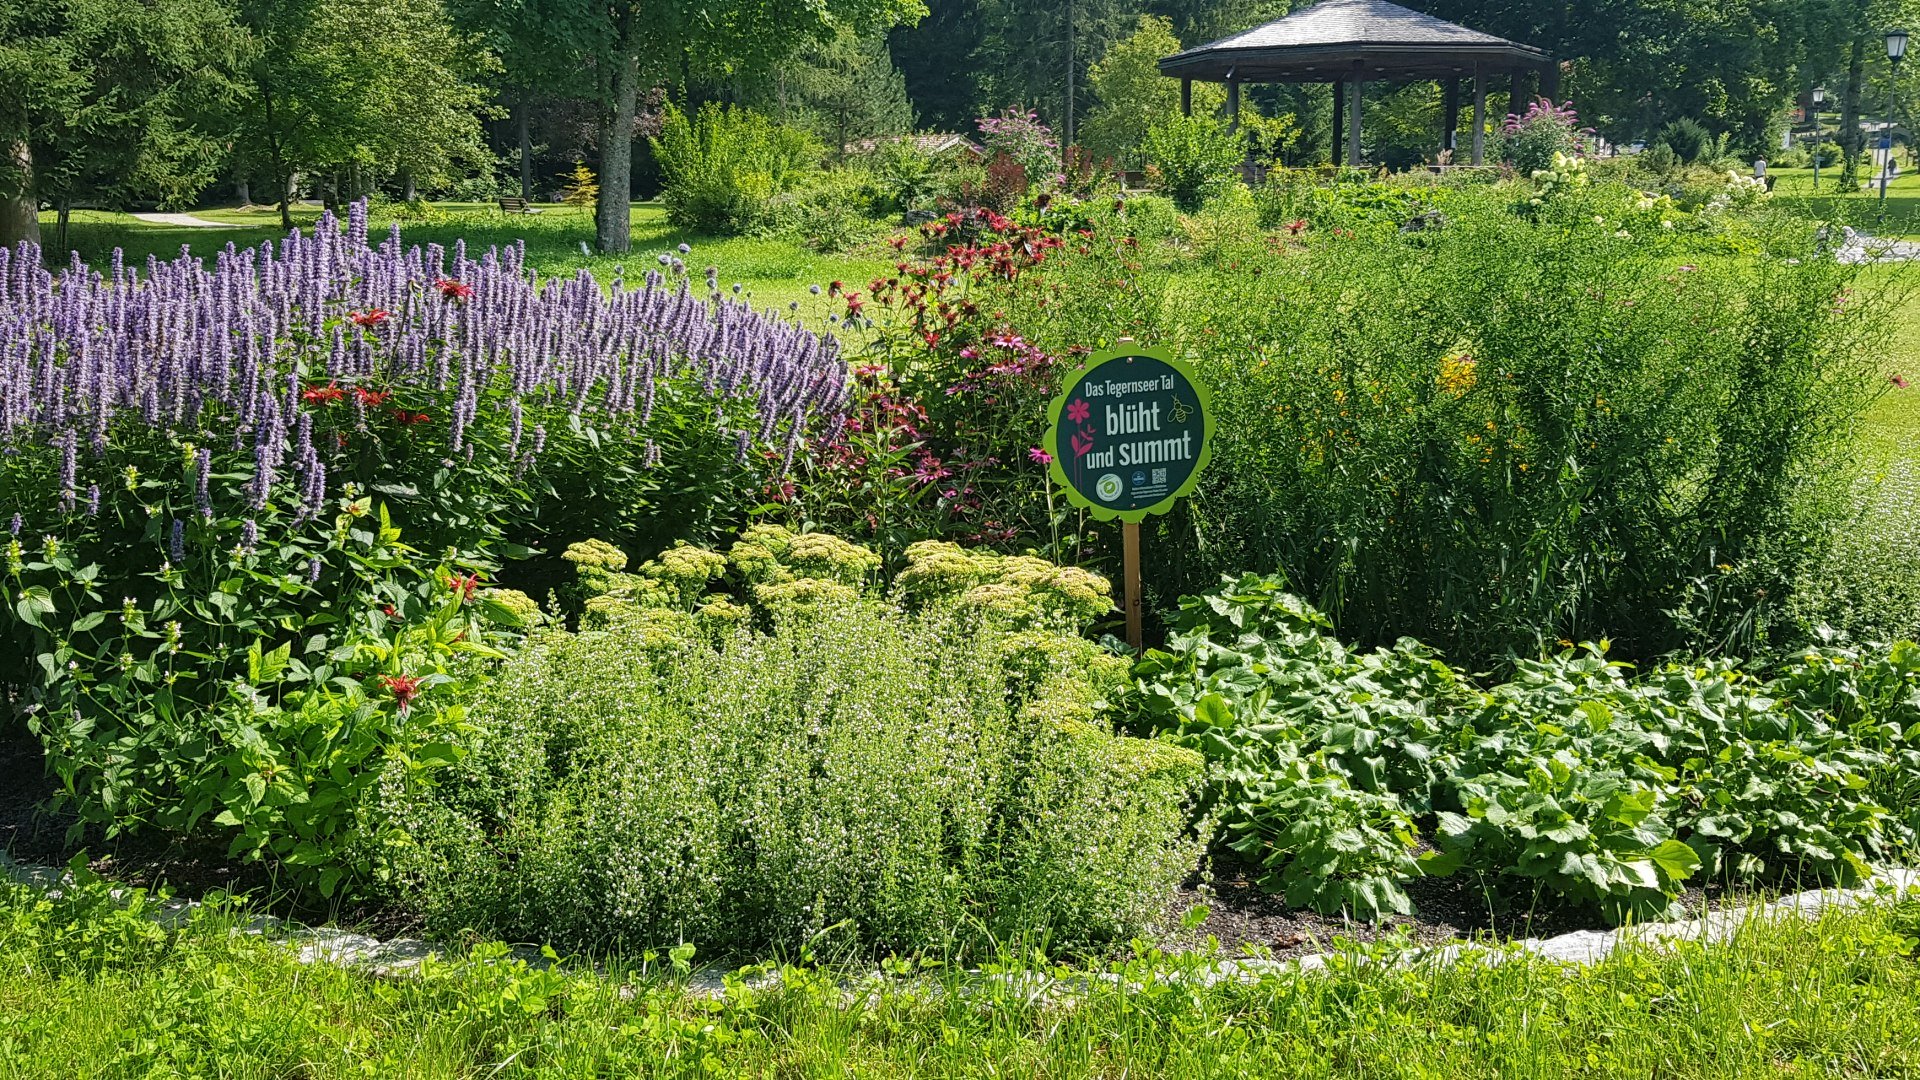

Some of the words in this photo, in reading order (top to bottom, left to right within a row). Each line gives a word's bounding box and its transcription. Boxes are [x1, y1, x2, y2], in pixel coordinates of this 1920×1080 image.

[1085, 381, 1104, 397] Das
[1105, 379, 1159, 398] Tegernseer
[1160, 374, 1174, 391] Tal
[1105, 401, 1160, 436] blüht
[1086, 446, 1114, 469] und
[1118, 430, 1191, 466] summt
